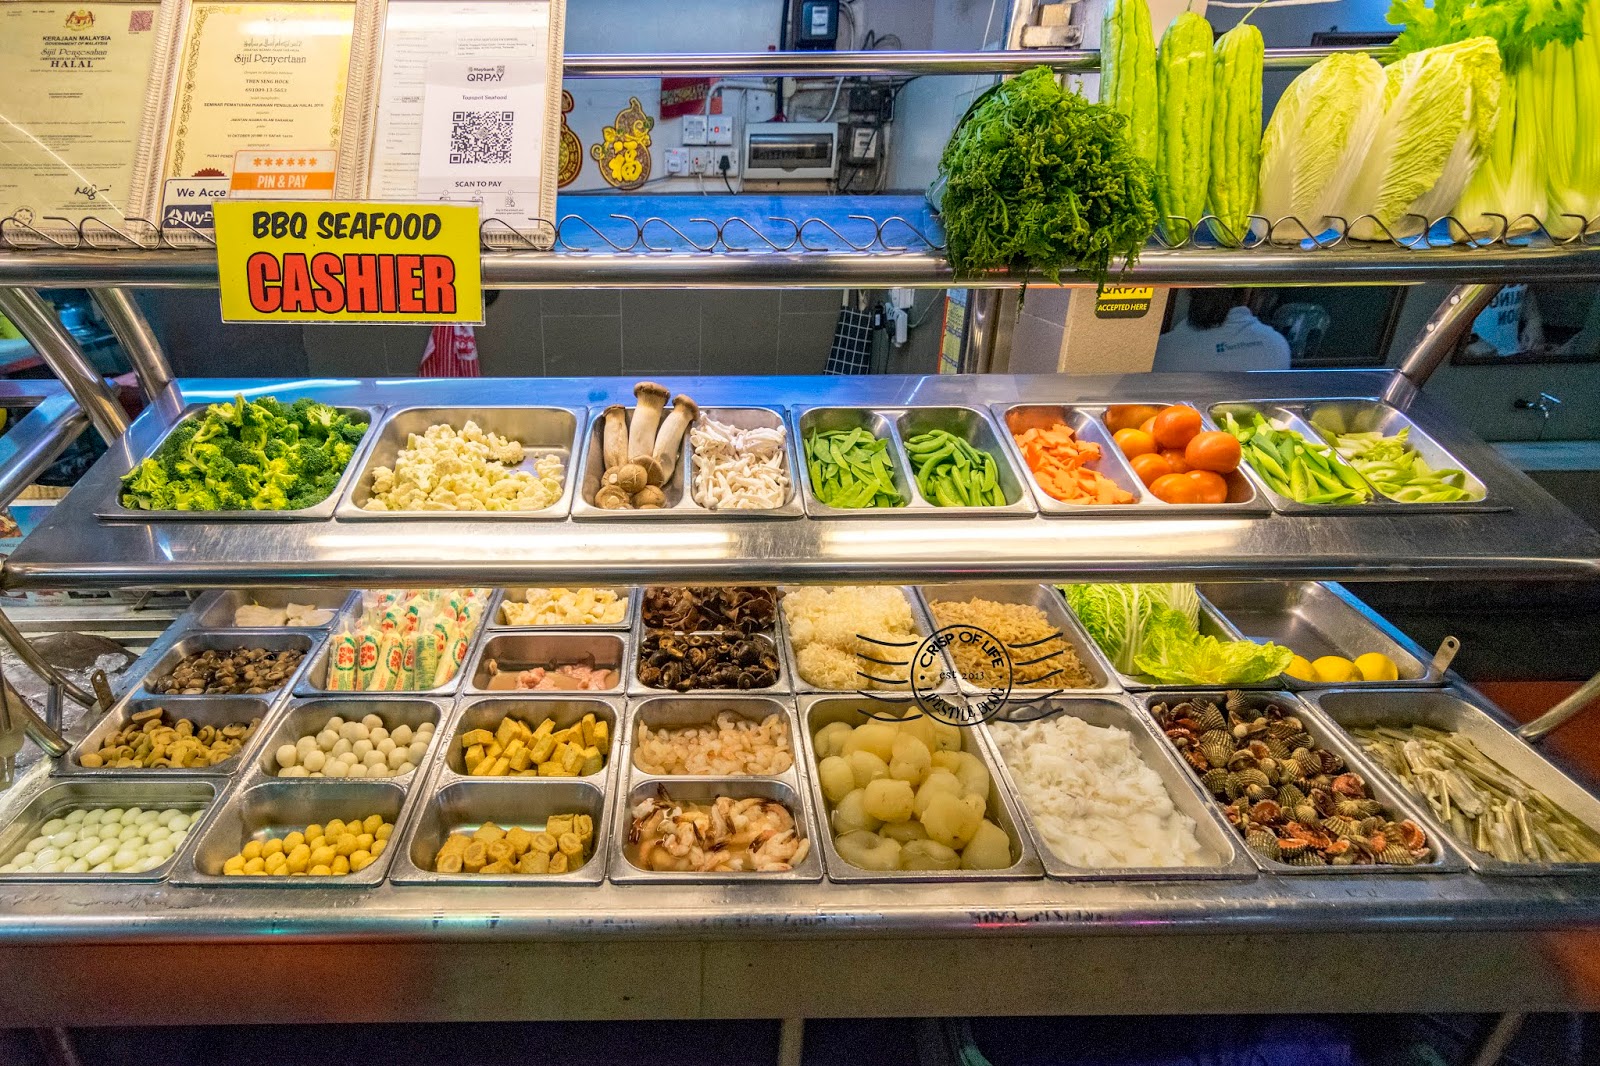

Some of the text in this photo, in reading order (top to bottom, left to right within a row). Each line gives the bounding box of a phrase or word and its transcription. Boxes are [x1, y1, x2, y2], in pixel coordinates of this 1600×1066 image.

[50, 60, 94, 68] HALAL
[233, 53, 307, 66] Sijil Penyertaan
[466, 73, 504, 82] QRPAY
[257, 175, 308, 188] PIN & PAY
[177, 188, 195, 197] We
[252, 211, 442, 241] BBQ SEAFOOD
[246, 251, 457, 314] CASHIER
[1130, 303, 1148, 311] HERE
